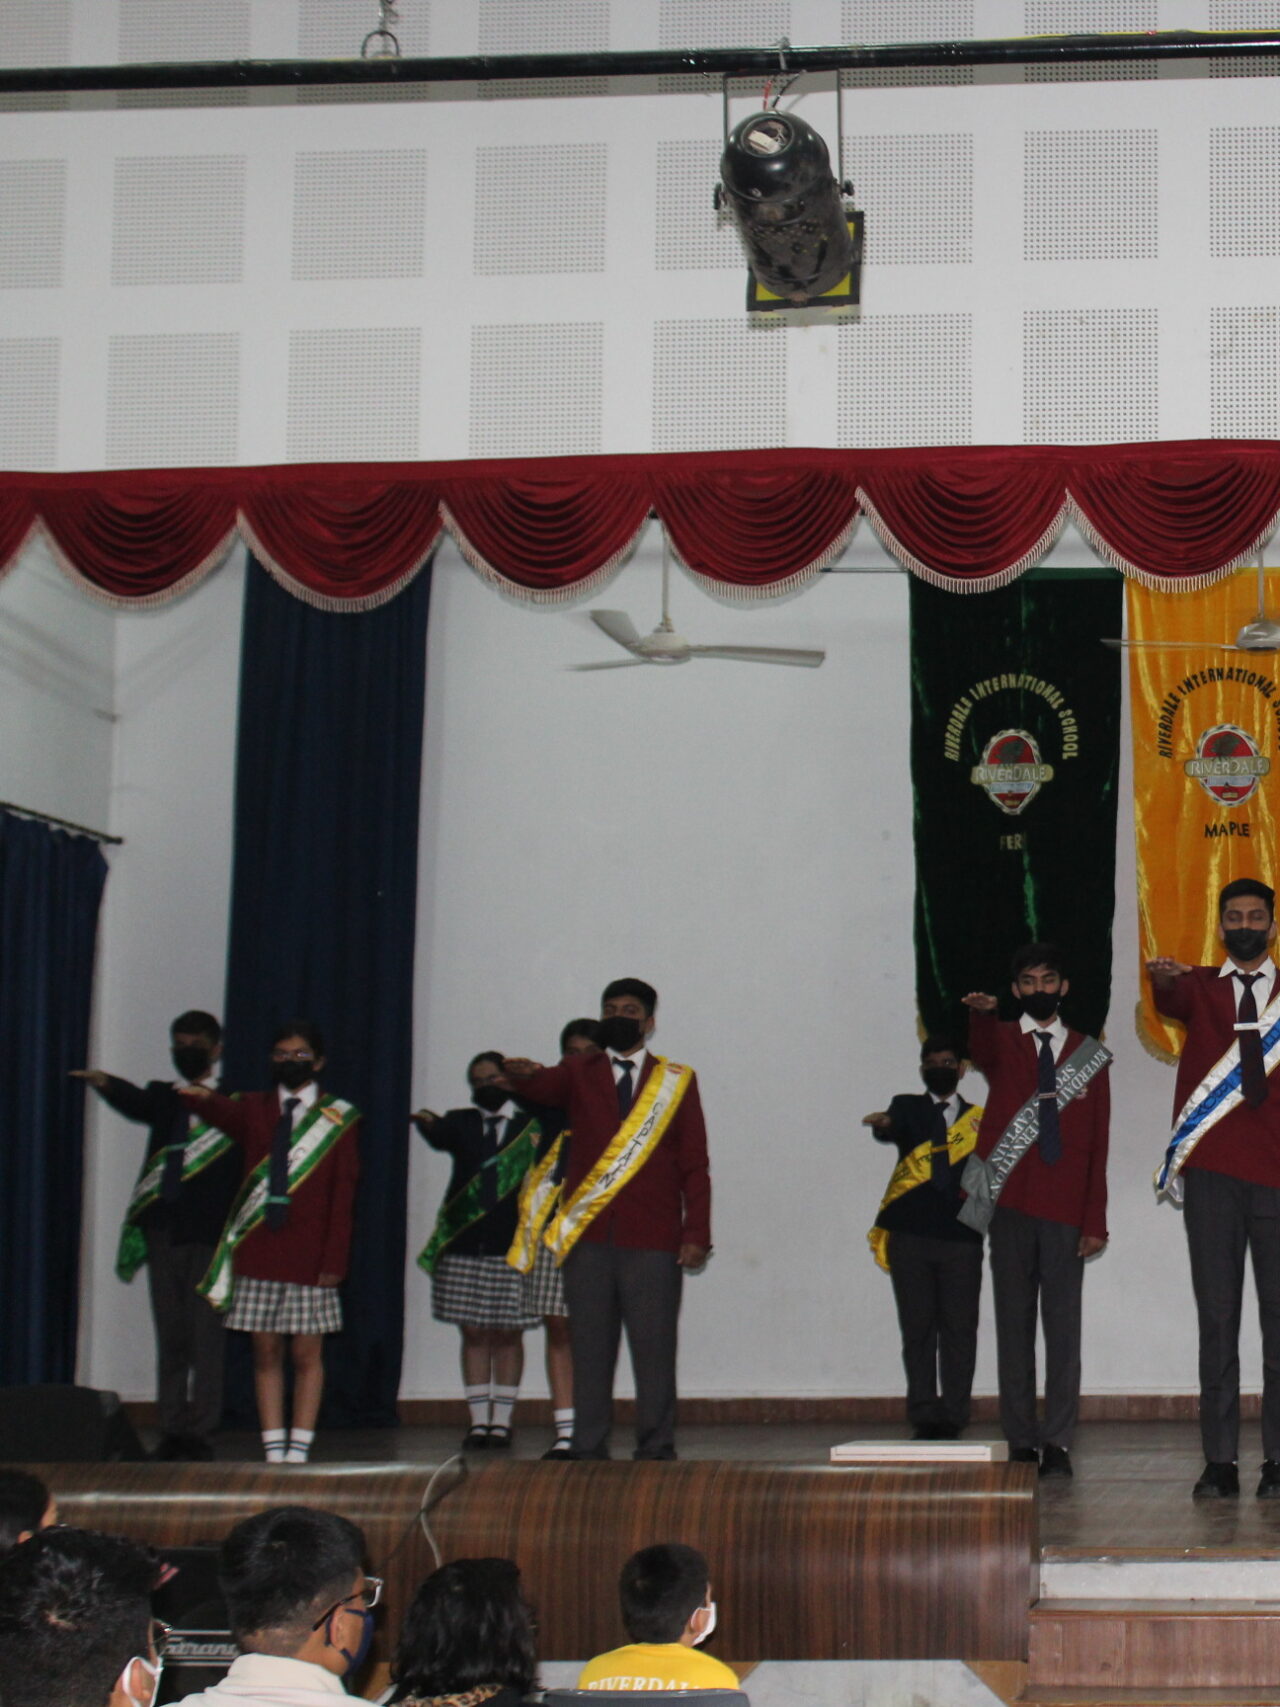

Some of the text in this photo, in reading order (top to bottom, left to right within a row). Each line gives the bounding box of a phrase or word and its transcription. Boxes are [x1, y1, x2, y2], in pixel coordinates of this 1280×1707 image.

[969, 673, 1065, 709] INTERNATIONAL
[1058, 709, 1079, 760] SCHOOL
[1158, 692, 1181, 759] RIVERDALE
[1177, 667, 1277, 699] INTERNATIONAL
[976, 767, 1047, 781] RIVERDALE
[1191, 759, 1265, 775] RIVERDALE
[1000, 834, 1026, 850] FER
[1204, 821, 1250, 837] MAPLE
[599, 1102, 664, 1189] CAPTAIN
[991, 1106, 1035, 1164] CAPTAIN
